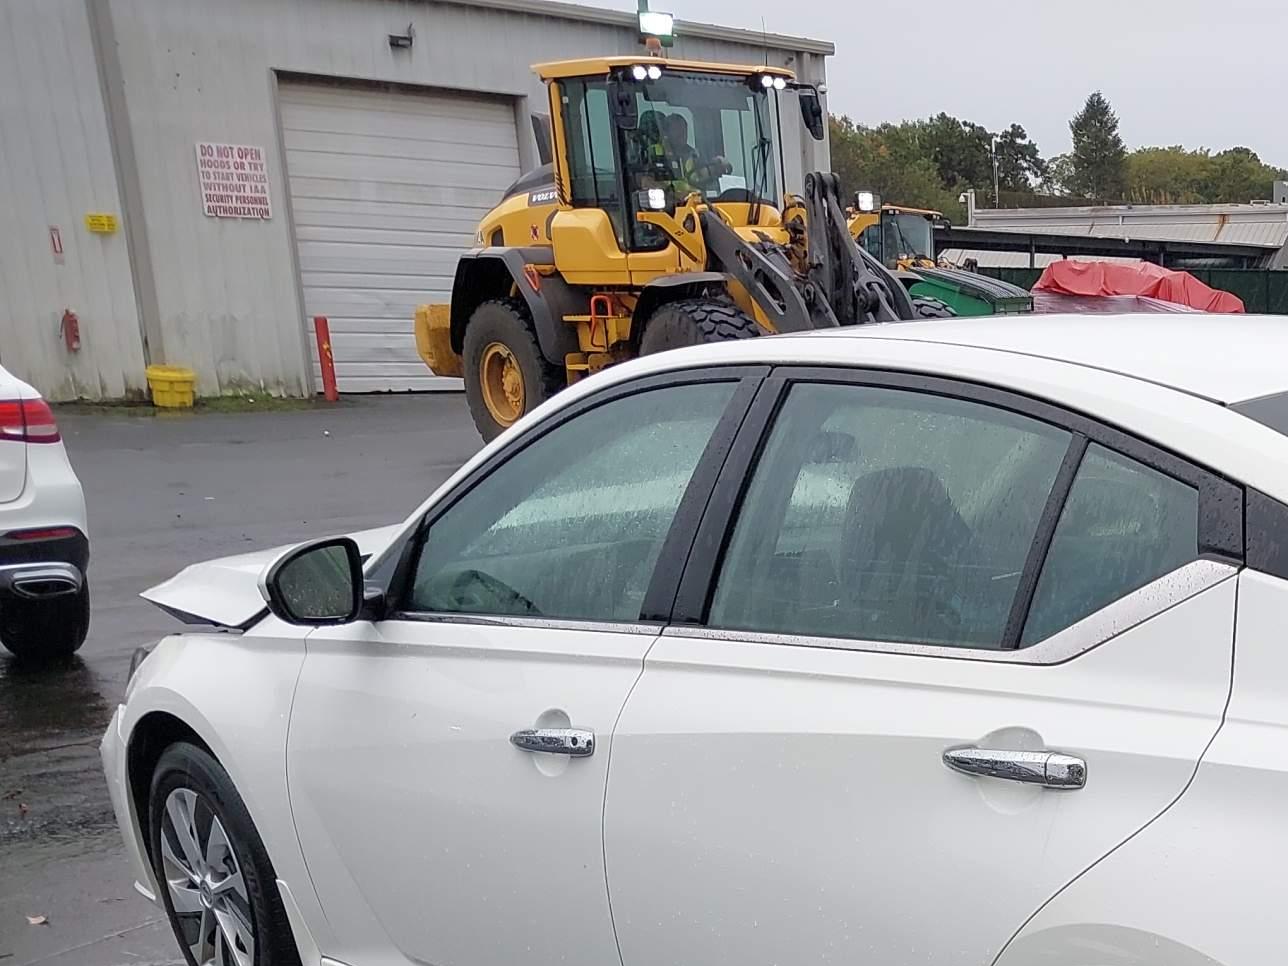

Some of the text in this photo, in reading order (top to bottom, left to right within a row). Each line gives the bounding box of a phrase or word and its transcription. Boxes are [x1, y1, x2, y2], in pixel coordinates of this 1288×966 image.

[200, 144, 261, 160] DO NOT OPEN
[200, 159, 264, 172] HOODS OR TRY
[201, 171, 267, 183] TO START VEHICLES
[203, 182, 267, 194] WITHOUT IAA
[205, 193, 269, 206] SECURITY PERSONNEL
[207, 205, 270, 217] AUTHORIZATION
